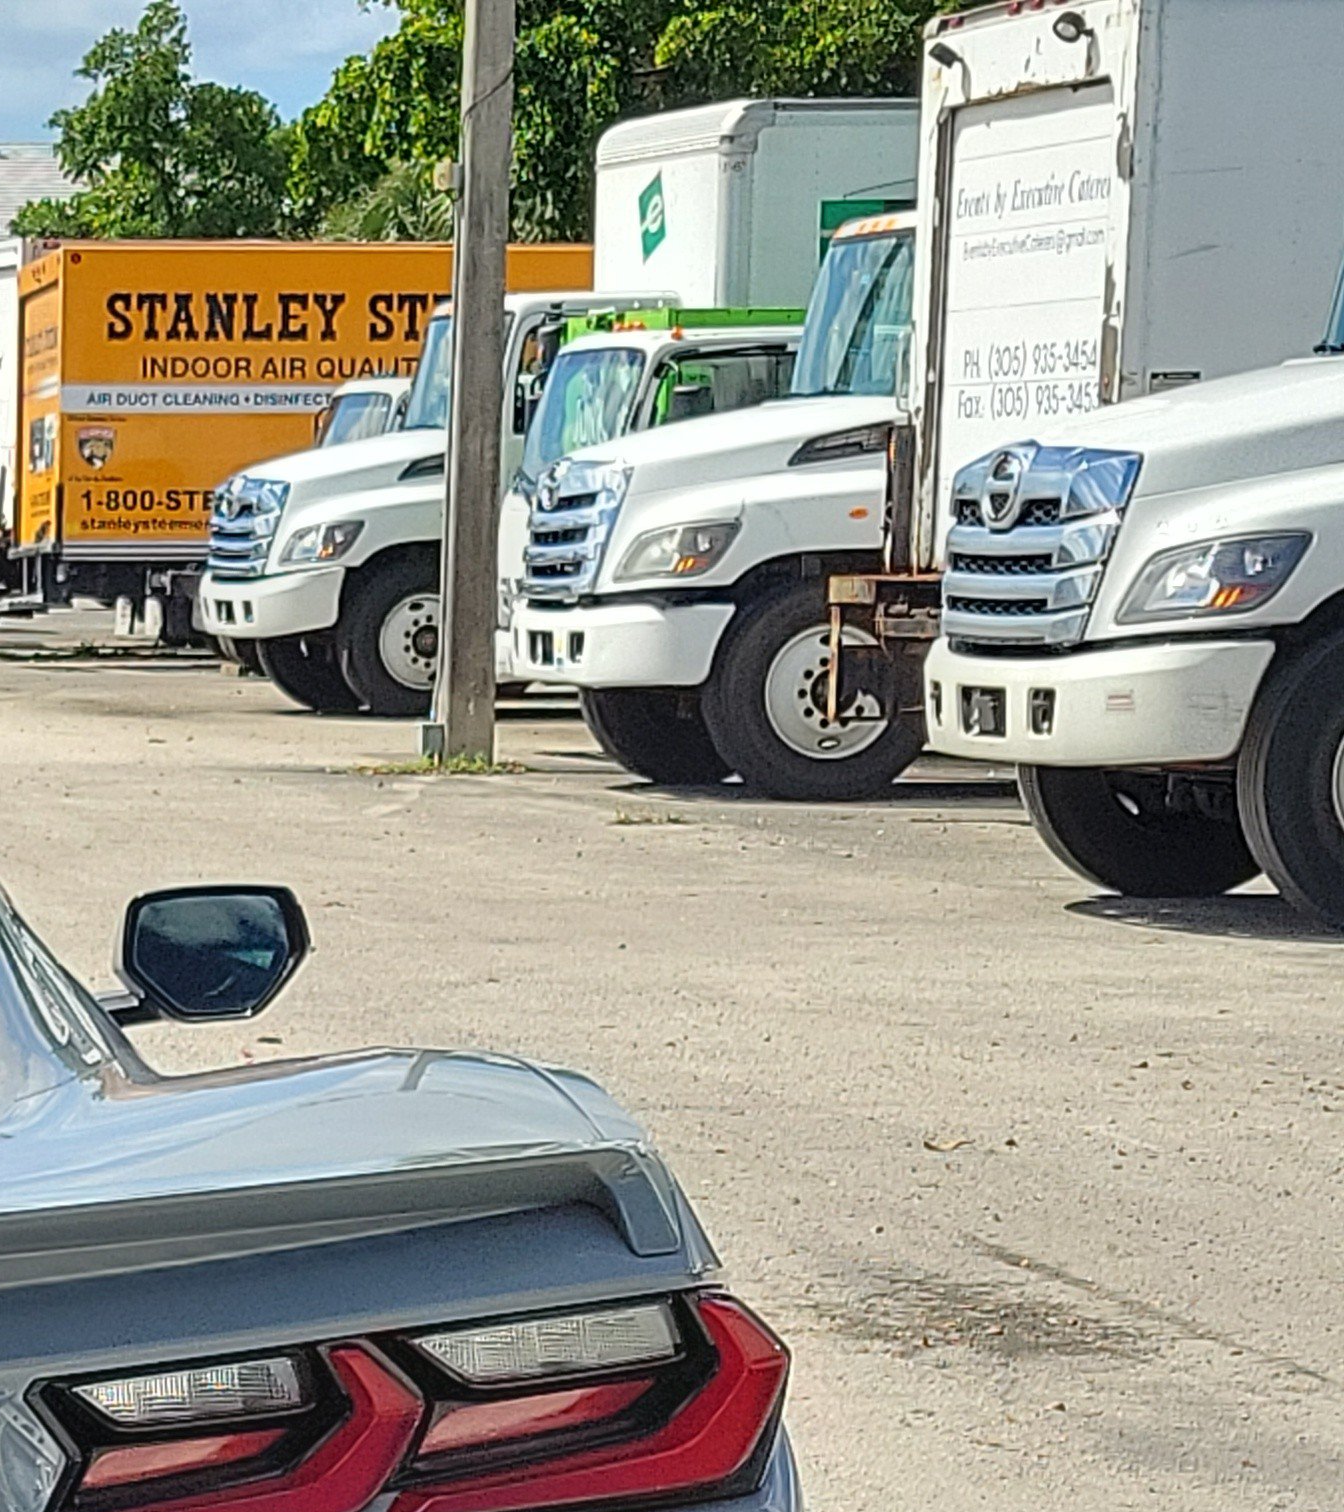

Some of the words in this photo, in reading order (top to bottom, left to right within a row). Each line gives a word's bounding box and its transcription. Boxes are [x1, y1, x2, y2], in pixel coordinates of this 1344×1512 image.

[994, 182, 1007, 219] by
[1011, 172, 1065, 212] Executive
[106, 292, 345, 341] STANLEY
[141, 356, 252, 379] INDOOR
[260, 356, 307, 379] AIR
[988, 340, 1027, 380] (305)
[1032, 339, 1097, 375] 935-3454
[86, 393, 112, 405] AIR
[116, 393, 157, 405] DUCT
[162, 393, 240, 406] CLEANING
[991, 381, 1029, 420] (305)
[1035, 381, 1100, 416] 935-3453
